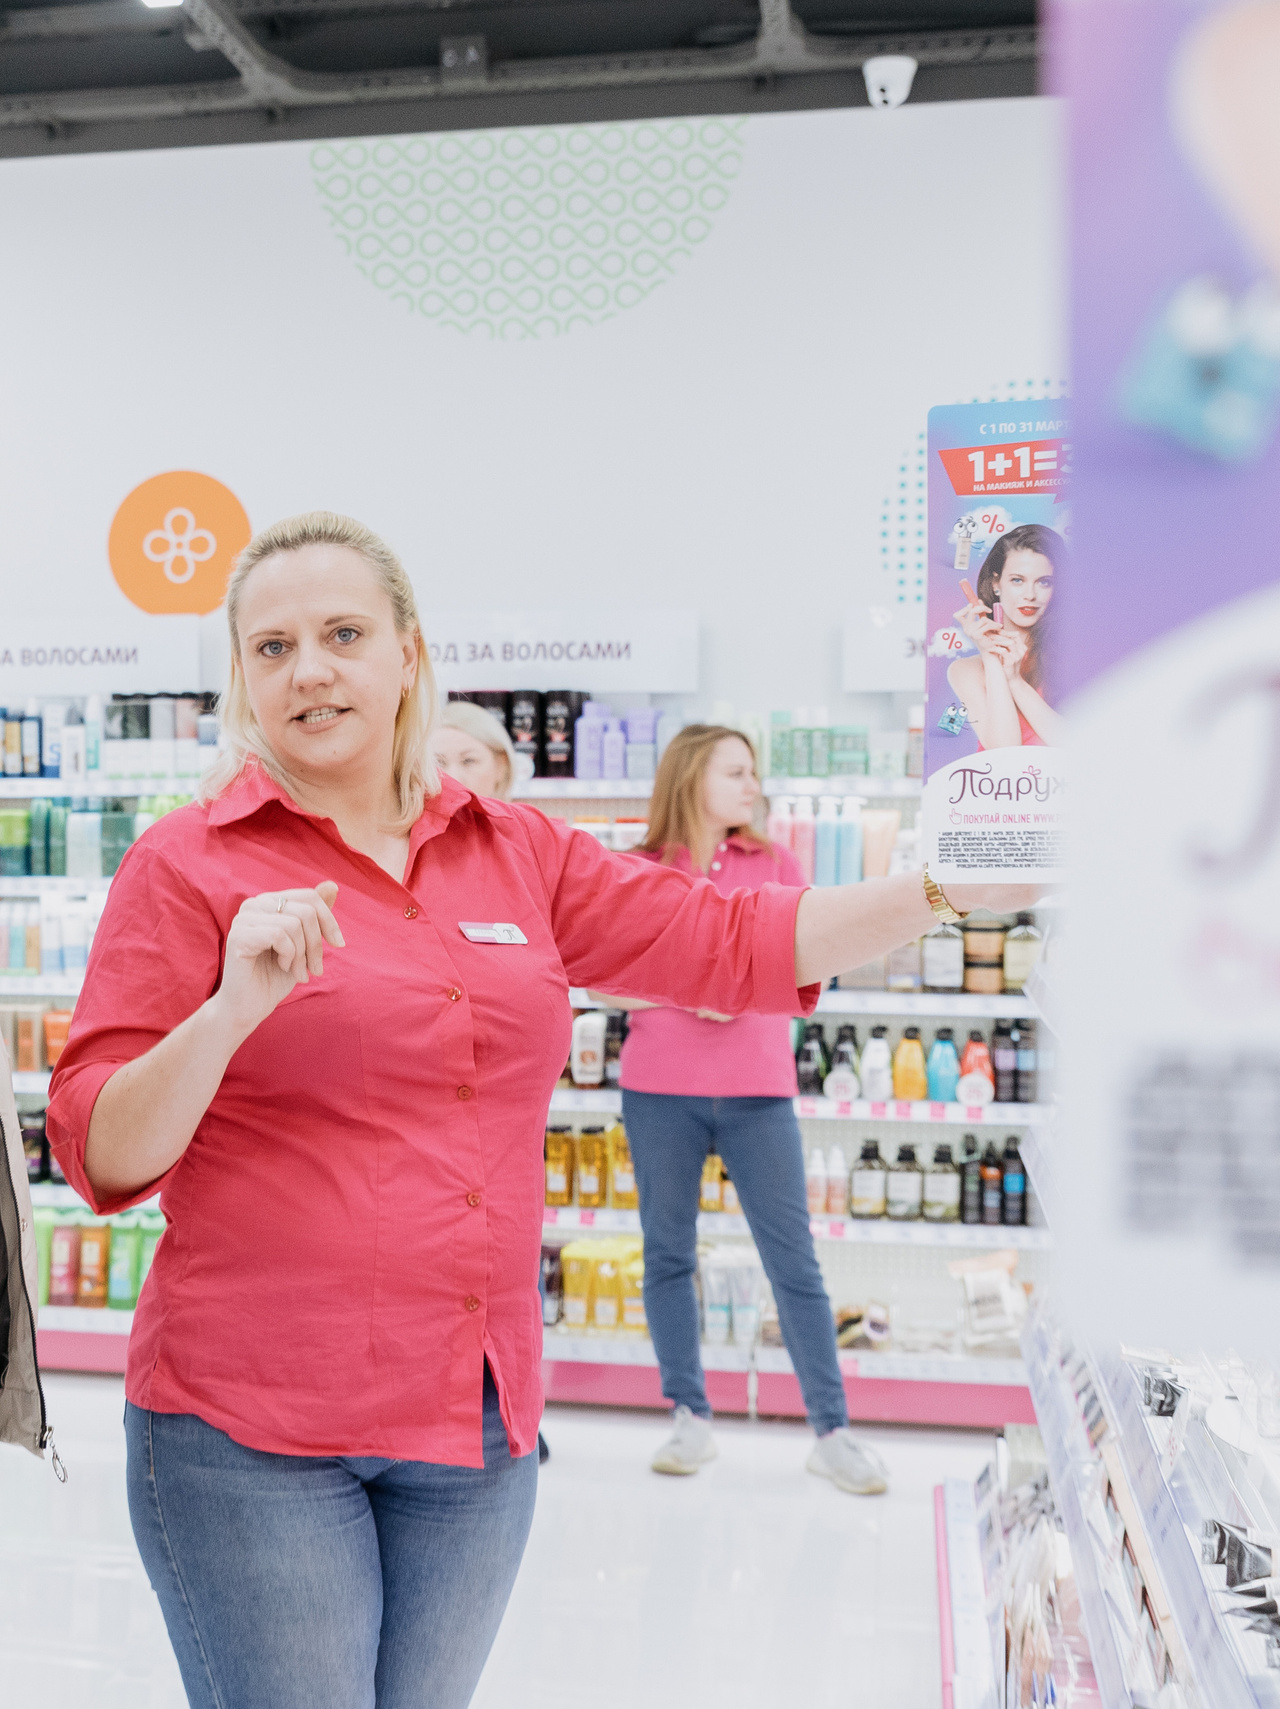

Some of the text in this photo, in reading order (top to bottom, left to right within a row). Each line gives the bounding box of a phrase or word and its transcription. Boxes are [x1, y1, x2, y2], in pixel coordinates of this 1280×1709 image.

[989, 424, 996, 434] 1
[999, 422, 1017, 433] ПО
[1019, 421, 1033, 432] 31
[1035, 419, 1069, 432] МАРТ
[986, 480, 1025, 491] МАКИЯЖ
[1026, 480, 1033, 488] И
[21, 647, 138, 666] ВОЛОСАМИ
[467, 642, 494, 661] ЗА
[502, 641, 631, 661] ВОЛОСАМИ
[963, 813, 1000, 824] ПОКУПАЙ
[1002, 813, 1031, 824] ONLINE
